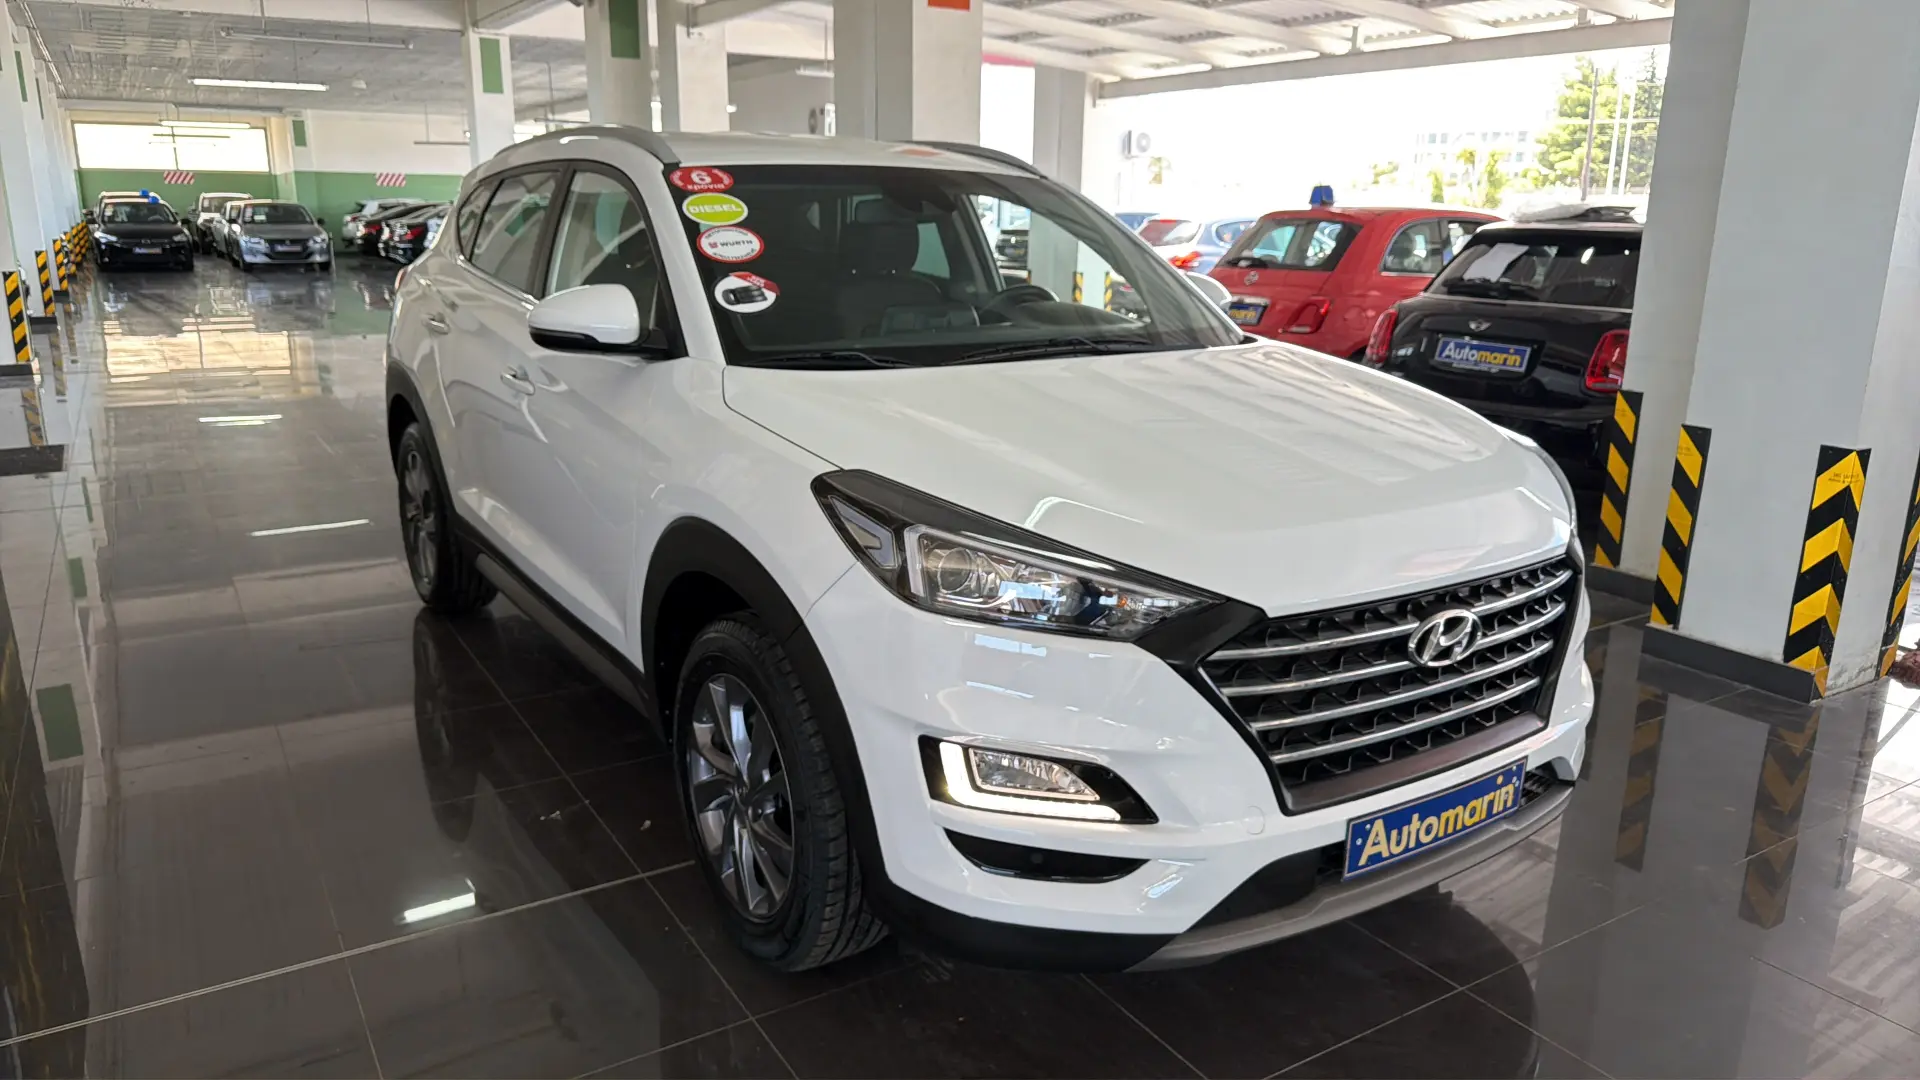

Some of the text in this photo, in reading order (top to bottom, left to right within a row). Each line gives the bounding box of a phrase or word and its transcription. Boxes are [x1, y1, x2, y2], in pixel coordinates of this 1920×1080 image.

[690, 170, 712, 184] 6
[689, 204, 742, 214] DIESEL
[1441, 341, 1521, 367] Automarin
[1358, 775, 1515, 866] Automarin
